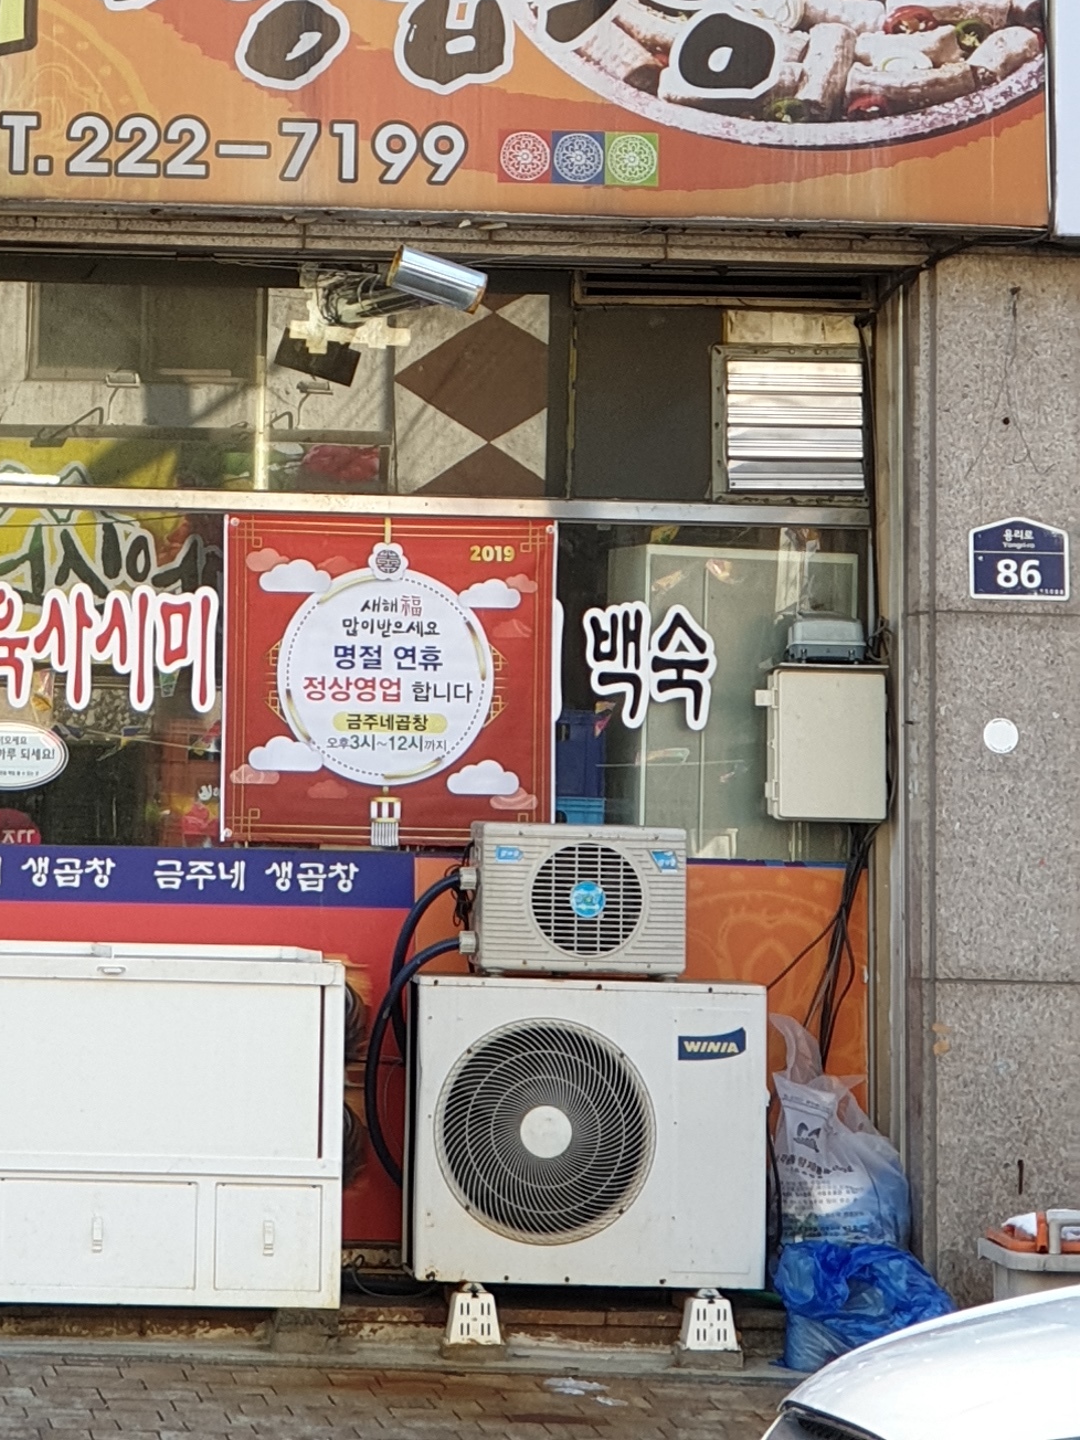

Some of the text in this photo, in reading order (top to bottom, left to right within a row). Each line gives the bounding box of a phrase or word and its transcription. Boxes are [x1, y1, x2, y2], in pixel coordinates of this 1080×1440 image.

[469, 545, 515, 562] 2019
[997, 559, 1042, 589] 86
[334, 644, 443, 672] 명절 연휴
[583, 600, 717, 731] 백숙
[303, 676, 473, 703] 정상영업 합니다
[346, 713, 428, 731] 금주네곱창
[21, 748, 55, 760] 되세요!
[20, 857, 115, 888] 생곱창
[153, 860, 245, 891] 금주네
[265, 861, 359, 893] 생곱창
[683, 1041, 739, 1053] WINIA
